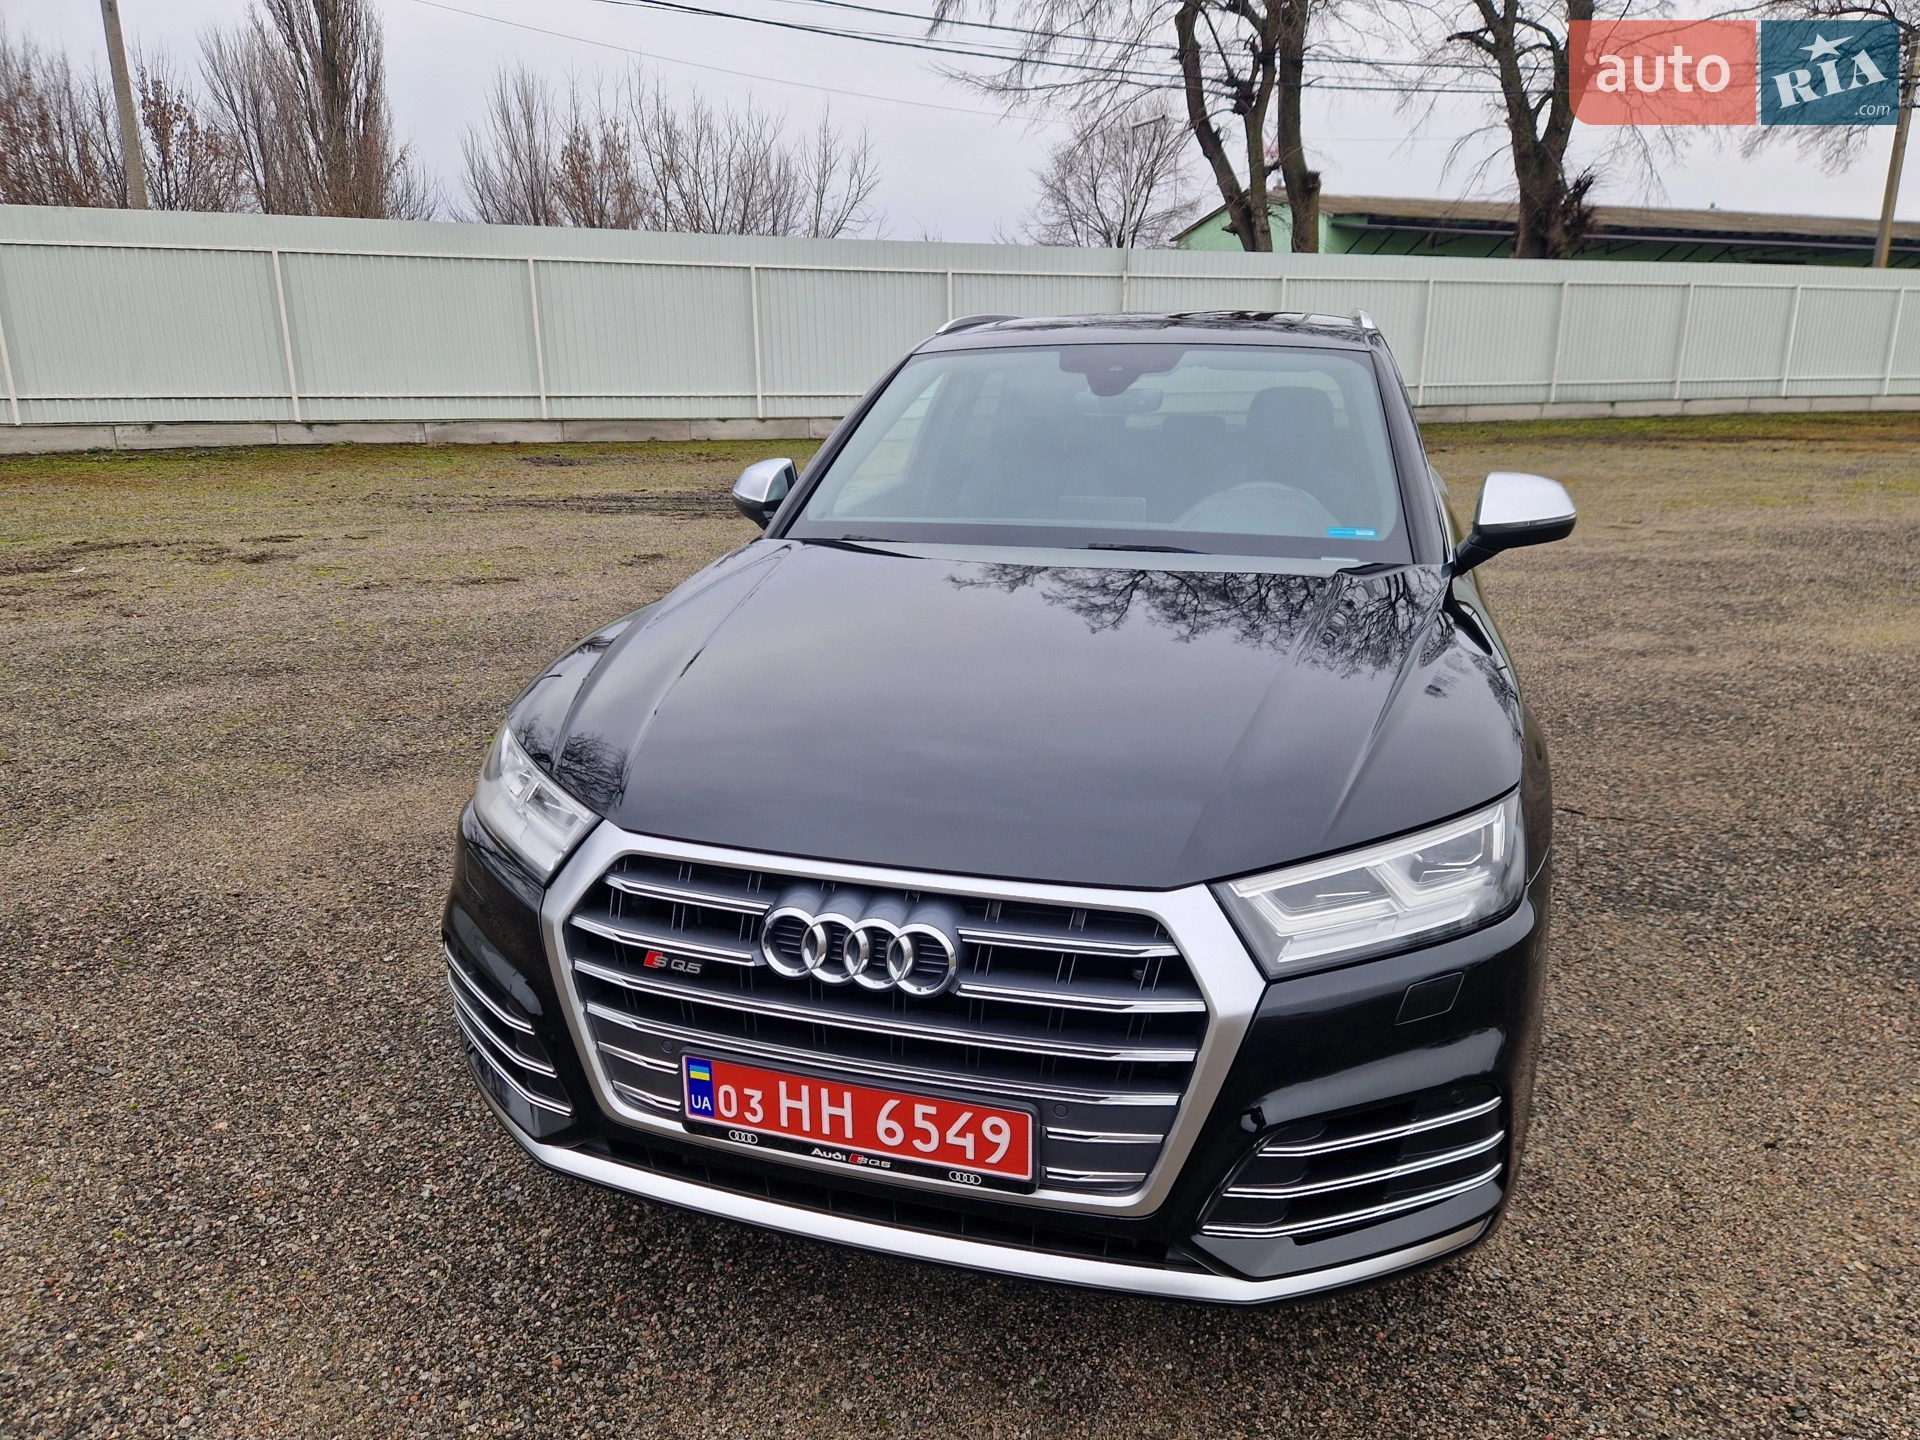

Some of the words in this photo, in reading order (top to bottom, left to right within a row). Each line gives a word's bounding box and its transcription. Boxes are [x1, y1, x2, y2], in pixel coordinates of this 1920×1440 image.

[692, 1094, 711, 1111] UA
[718, 1084, 764, 1124] 03
[778, 1080, 854, 1139] HH
[876, 1099, 1011, 1164] 6549
[811, 1147, 846, 1161] Audi
